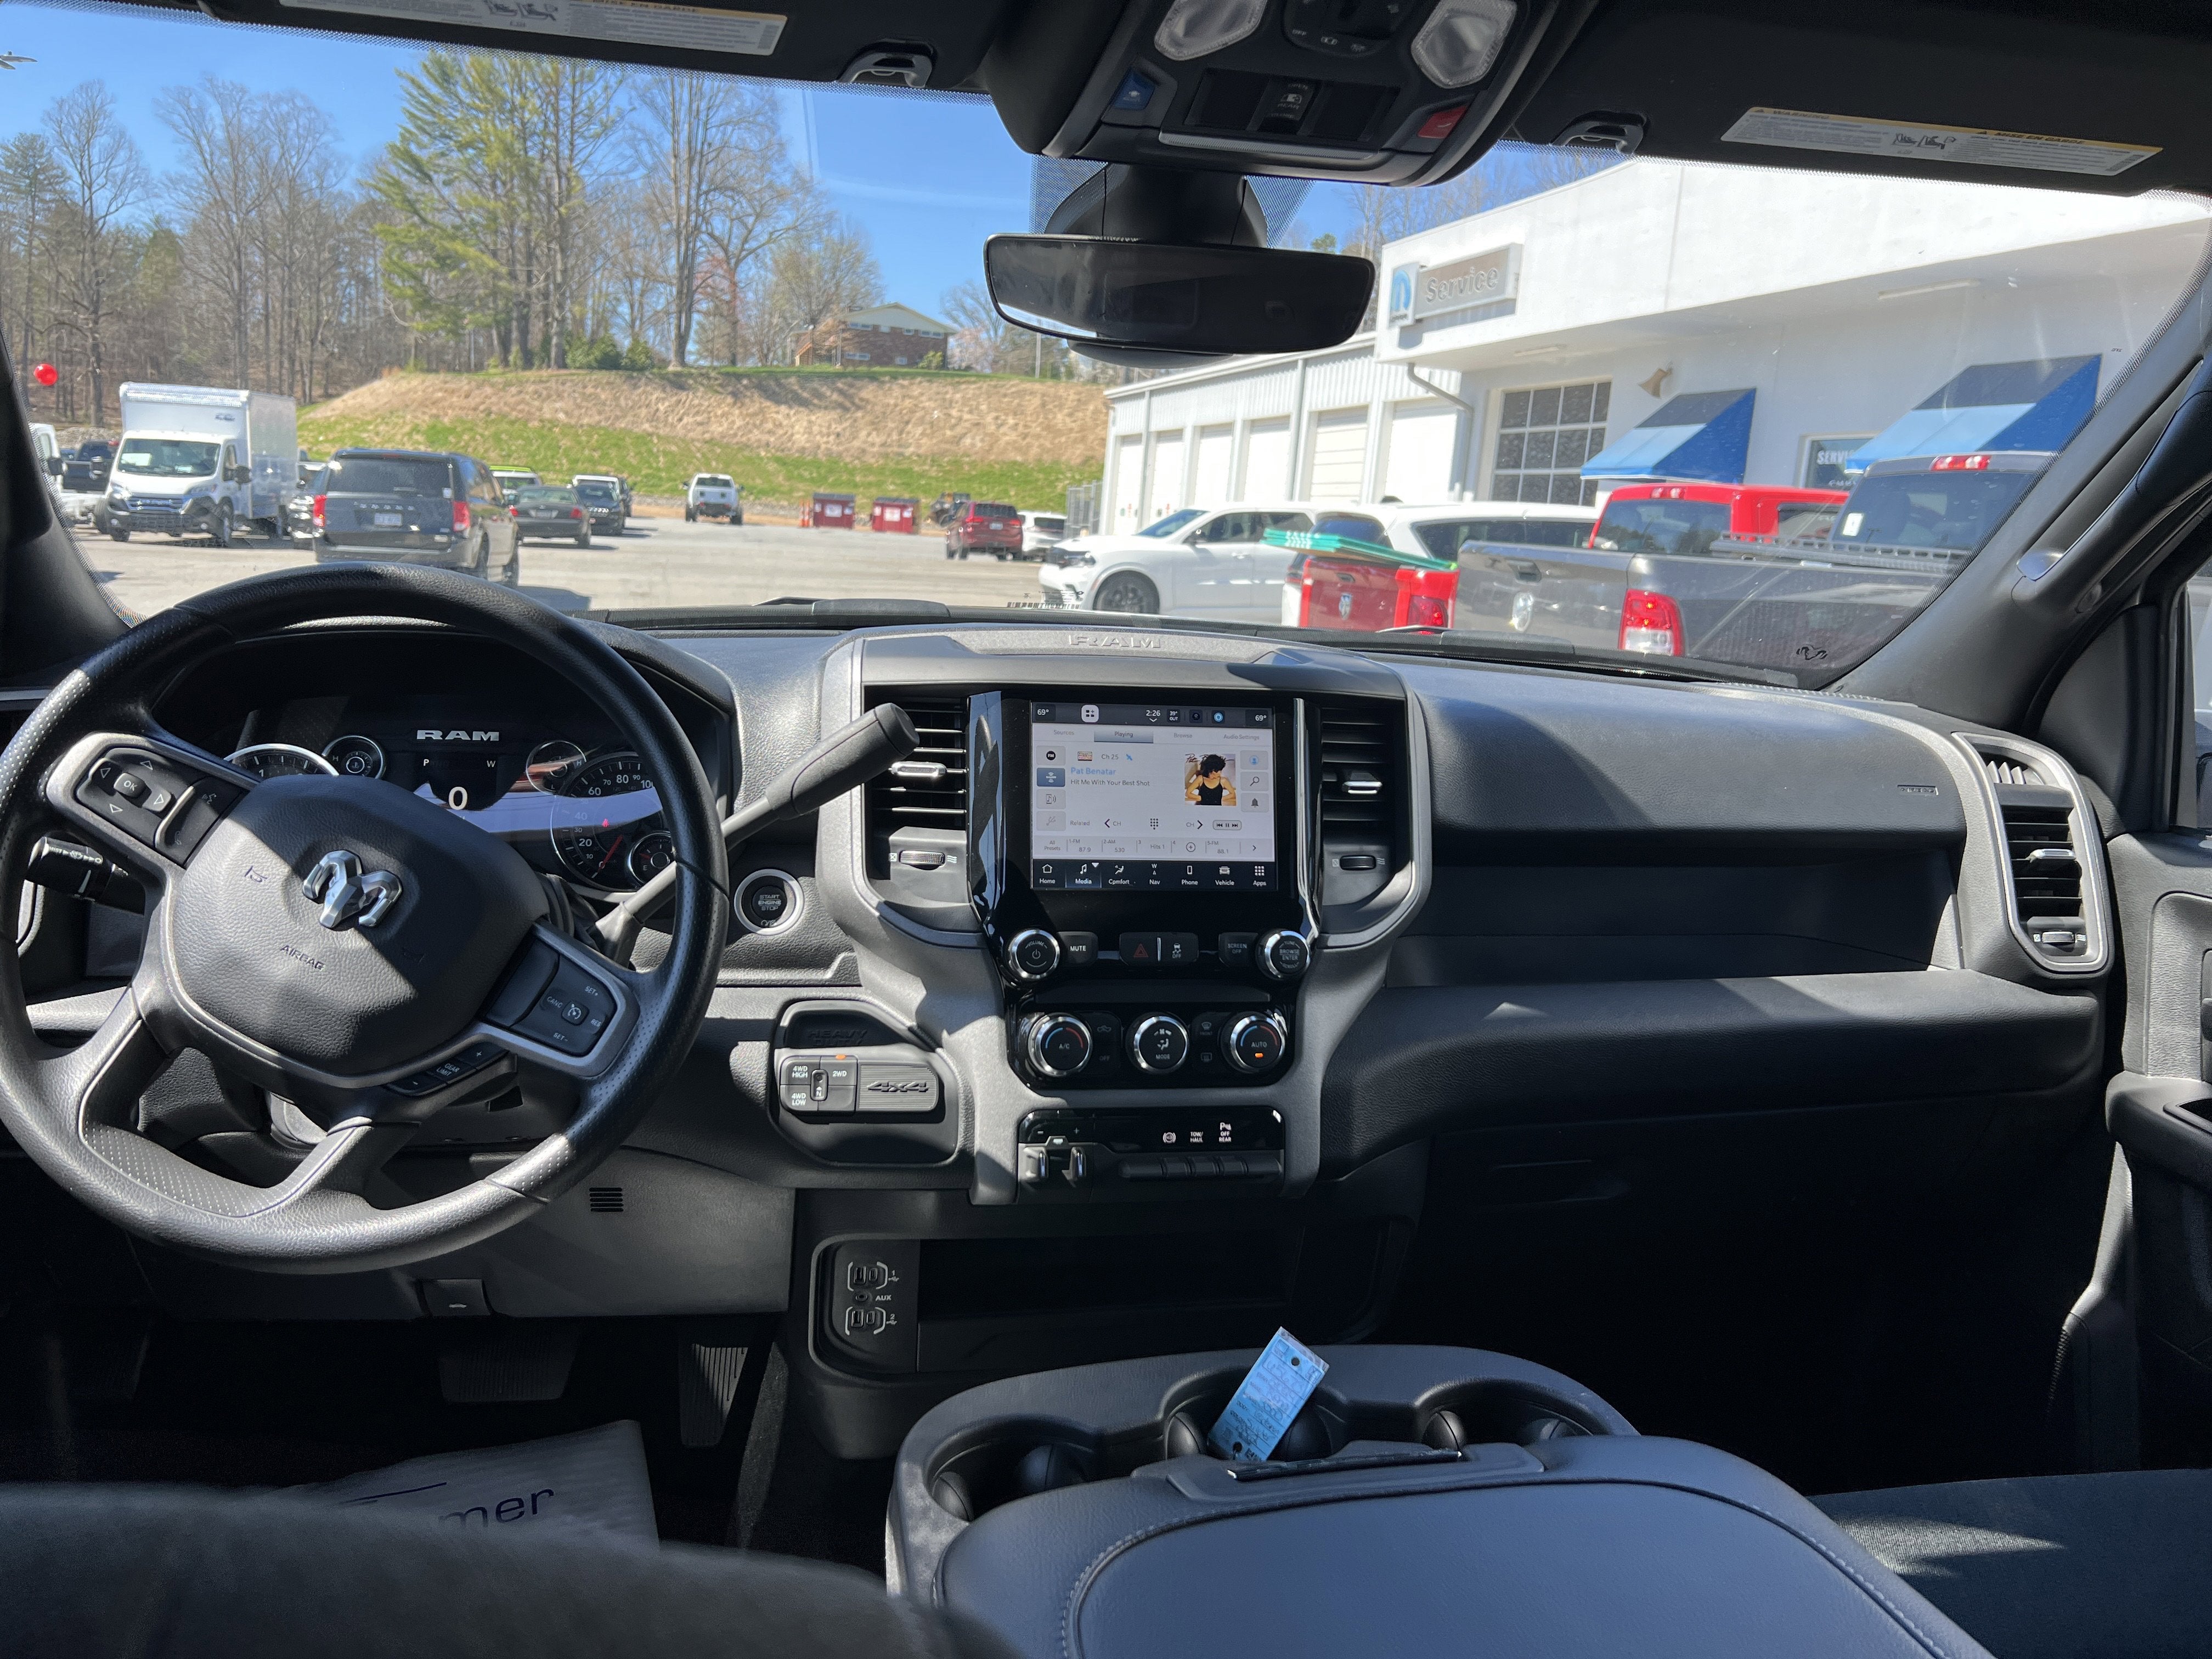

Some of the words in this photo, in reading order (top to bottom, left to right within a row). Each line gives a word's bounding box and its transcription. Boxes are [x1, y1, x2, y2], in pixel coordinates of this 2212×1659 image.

[1426, 267, 1499, 302] Service
[1069, 635, 1161, 648] RAM
[417, 730, 499, 741] RAM
[617, 775, 629, 783] 80
[123, 780, 138, 791] OK
[588, 787, 601, 795] 60
[448, 786, 468, 810] 0
[579, 838, 592, 847] 20
[280, 945, 325, 971] AIRBAG
[808, 1029, 868, 1038] HEAVY
[436, 1067, 452, 1076] LIMIT
[444, 1063, 460, 1073] GEAR
